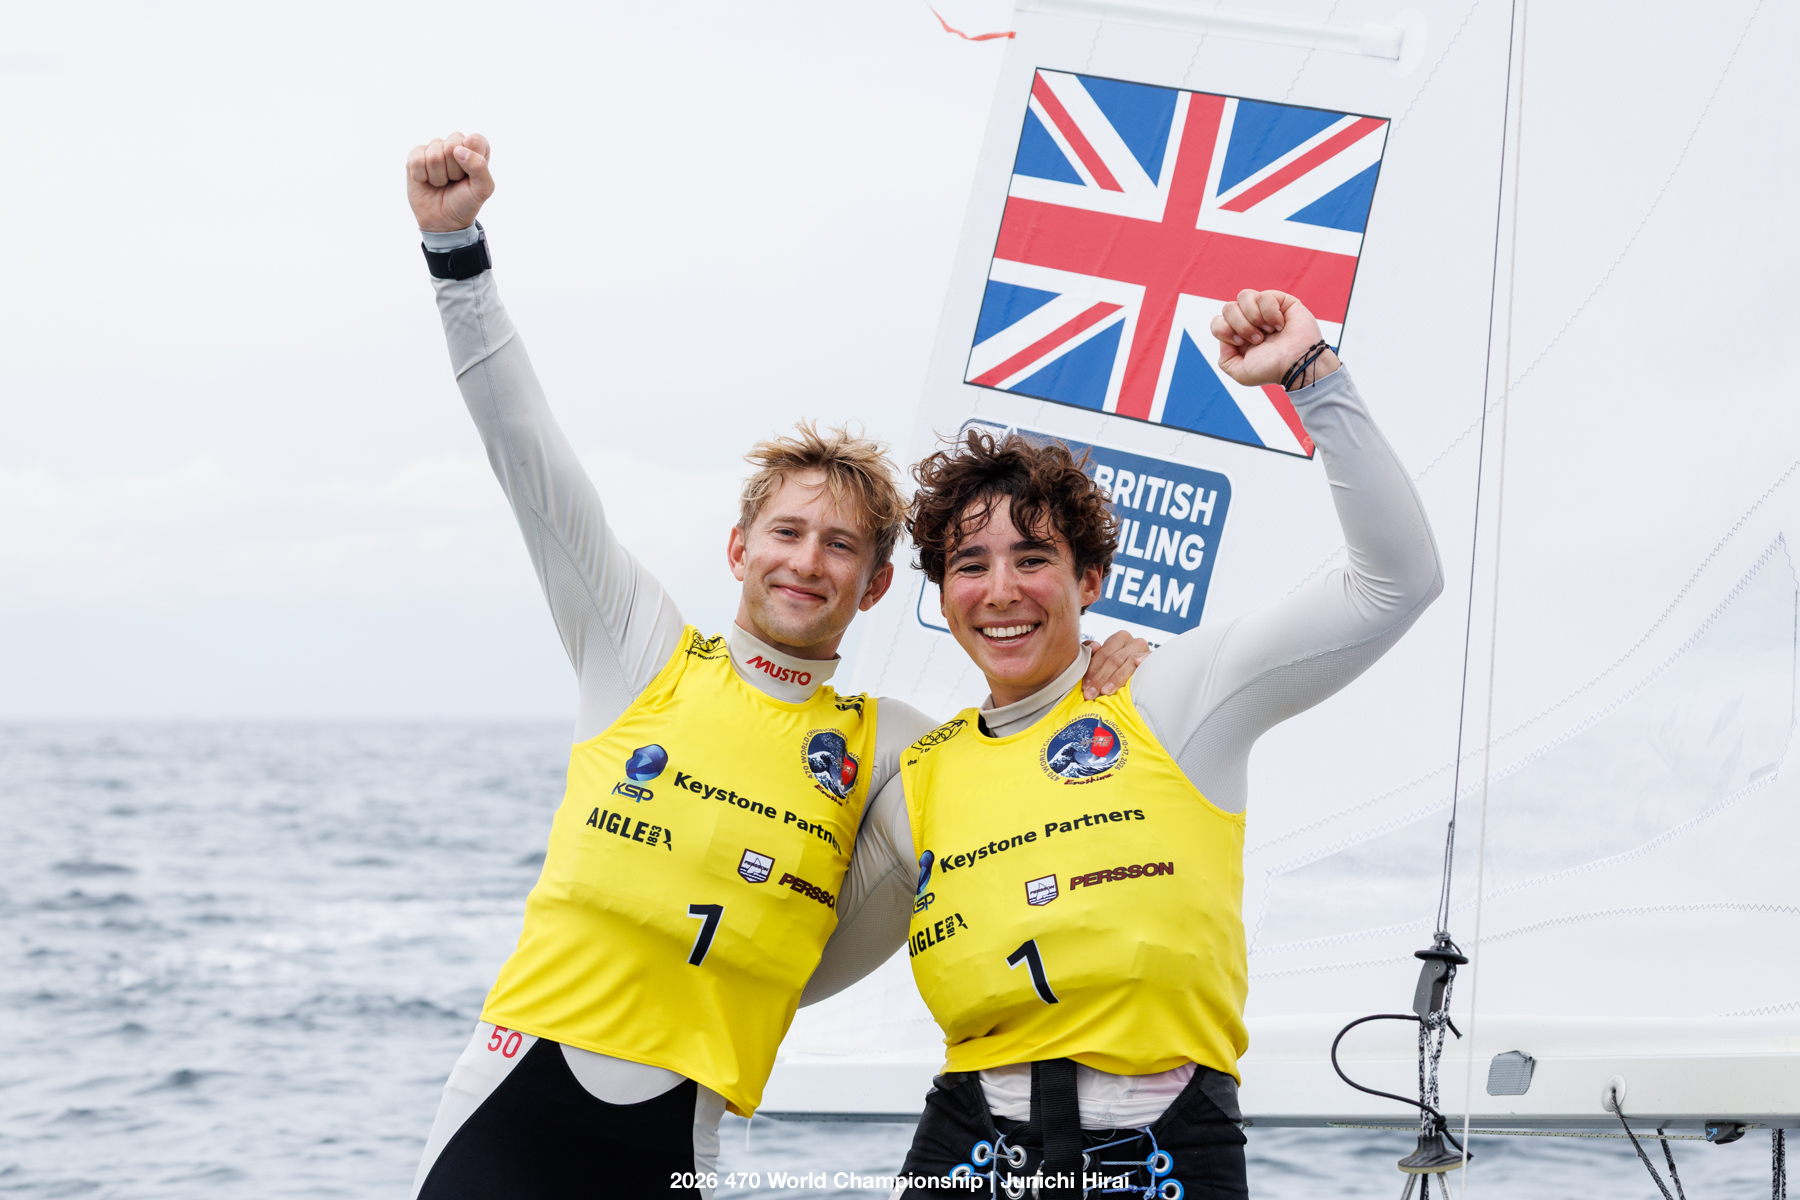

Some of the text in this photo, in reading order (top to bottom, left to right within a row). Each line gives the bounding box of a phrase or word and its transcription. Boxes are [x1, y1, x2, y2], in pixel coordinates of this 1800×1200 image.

[1094, 464, 1217, 526] BRITISH
[1106, 515, 1205, 571] ILING
[1105, 563, 1195, 619] TEAM
[745, 655, 812, 686] MUSTO
[1104, 719, 1126, 739] AUGUST
[801, 737, 810, 763] WORLD
[1039, 748, 1049, 773] WORLD
[1115, 757, 1127, 771] 2026
[803, 765, 813, 779] 470
[1047, 771, 1060, 781] 470
[1064, 773, 1114, 785] Enoshima
[611, 782, 654, 803] KSP
[586, 807, 662, 846] AIGLE 1853
[674, 771, 842, 855] Keystone Partners
[940, 809, 1145, 873] Keystone Partners
[778, 872, 836, 911] PERSSO
[1070, 862, 1174, 891] PERSSON
[687, 903, 725, 967] 1
[945, 916, 955, 938] 1853
[1005, 939, 1060, 1004] 1
[487, 1025, 523, 1058] 50
